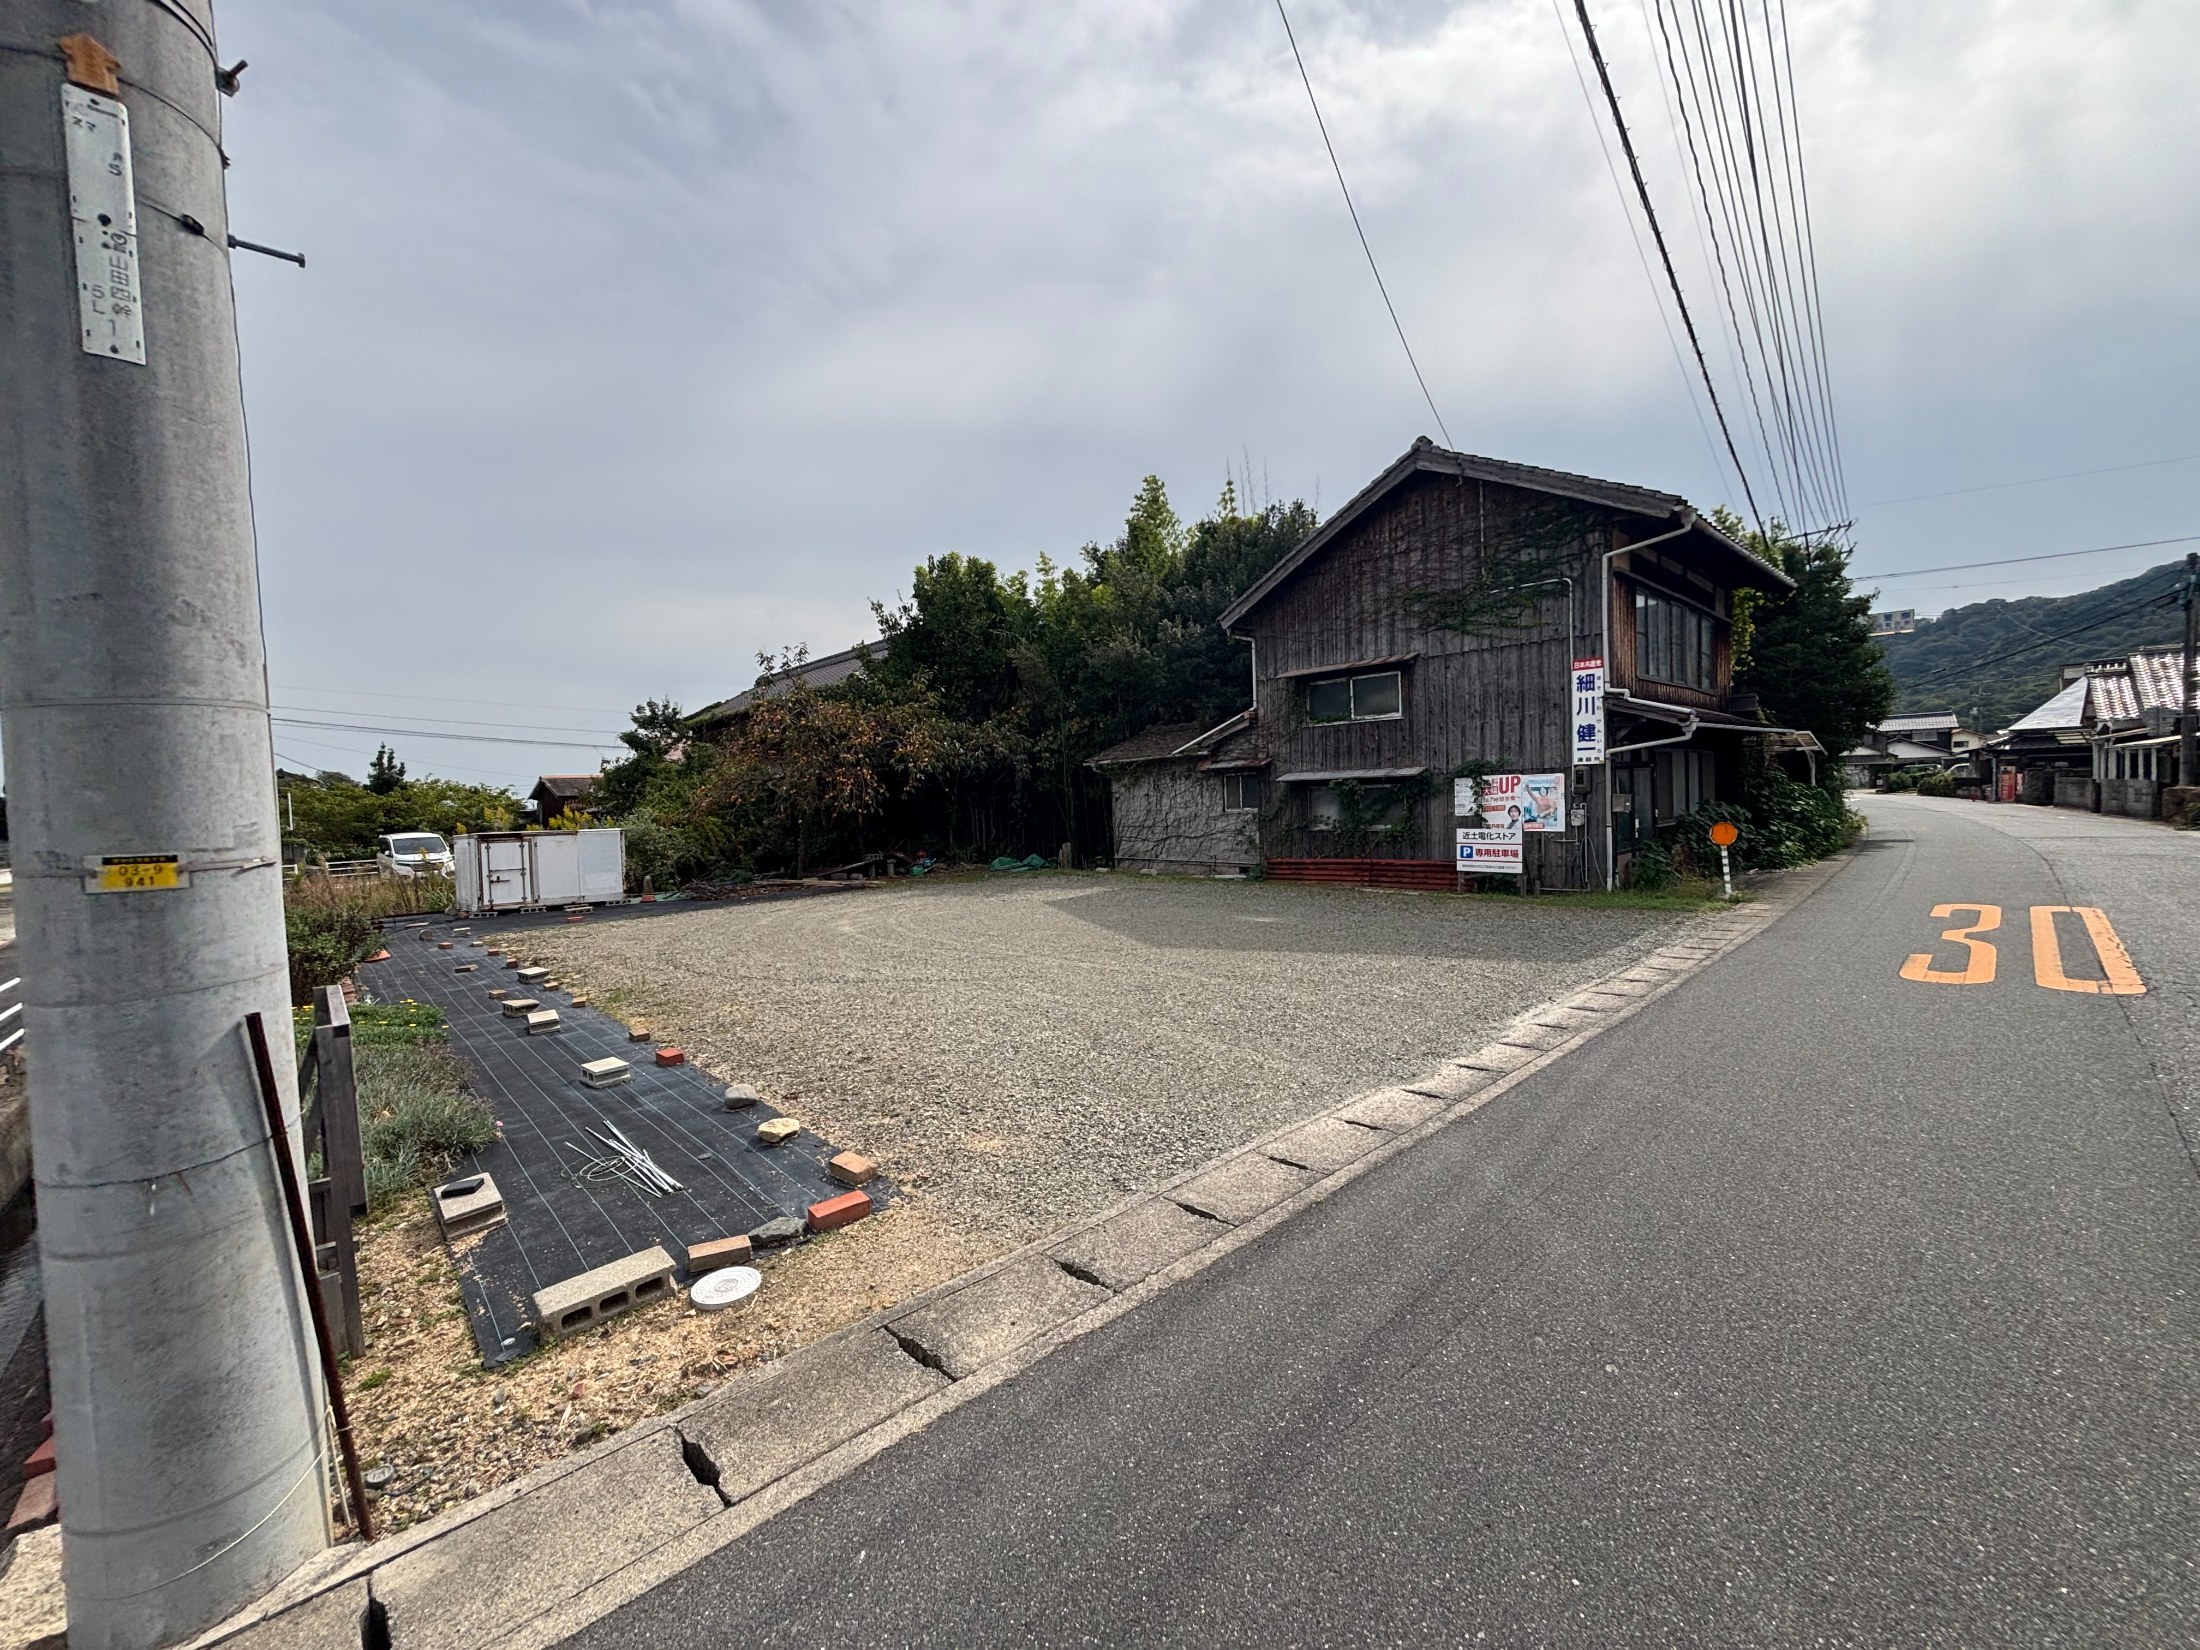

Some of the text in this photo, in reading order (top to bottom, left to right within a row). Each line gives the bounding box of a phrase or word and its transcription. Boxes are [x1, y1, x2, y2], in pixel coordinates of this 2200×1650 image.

[1576, 673, 1596, 751] 細川健一
[1499, 775, 1521, 794] UP
[1462, 832, 1516, 841] 近土電化ストア
[1463, 847, 1471, 857] P
[1475, 848, 1519, 859] 専用駐車場
[1900, 904, 2147, 996] 30
